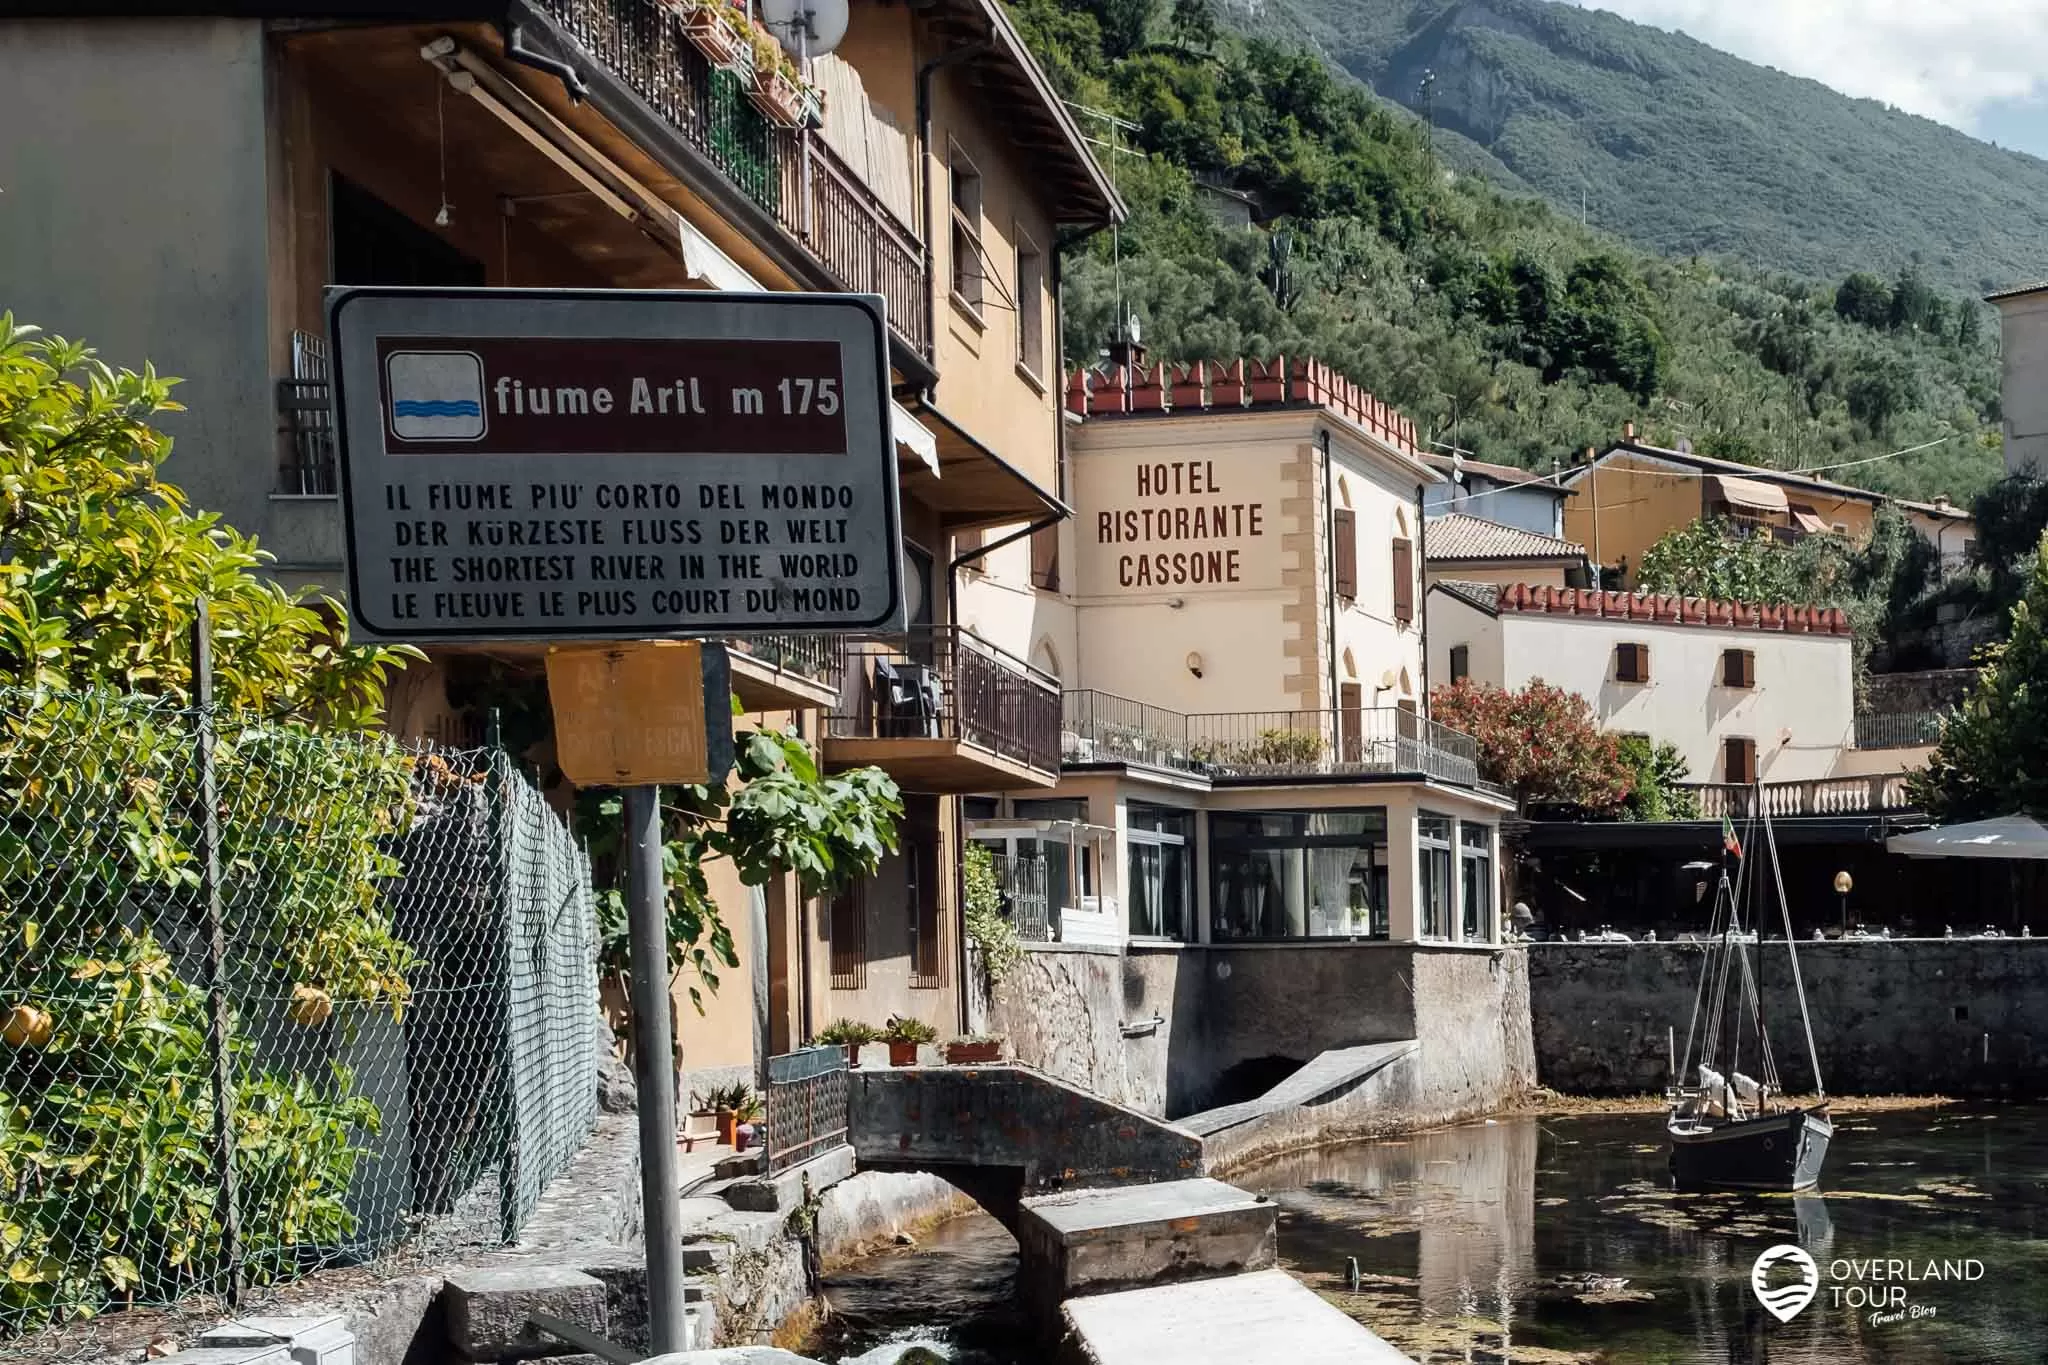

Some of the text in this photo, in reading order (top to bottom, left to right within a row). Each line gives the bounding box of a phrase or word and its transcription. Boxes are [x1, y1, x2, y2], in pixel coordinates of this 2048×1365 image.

[494, 377, 840, 416] fiume Aril m 175
[1137, 461, 1221, 497] HOTEL
[386, 484, 411, 510] IL
[429, 484, 513, 510] FIUME
[596, 484, 681, 509] CORTO
[699, 484, 745, 509] DEL
[761, 484, 853, 509] MONDO
[395, 521, 448, 546] DER
[623, 519, 702, 545] FLUSS
[720, 519, 770, 545] DER
[786, 519, 848, 544] WELT
[1098, 503, 1264, 544] RISTORANTE
[390, 553, 858, 583] THE SHORTEST RIVER IN THE WORLD
[1119, 549, 1240, 588] CASSONE
[391, 588, 860, 619] LE FLEUVE LE PLUS COURT DU MOND
